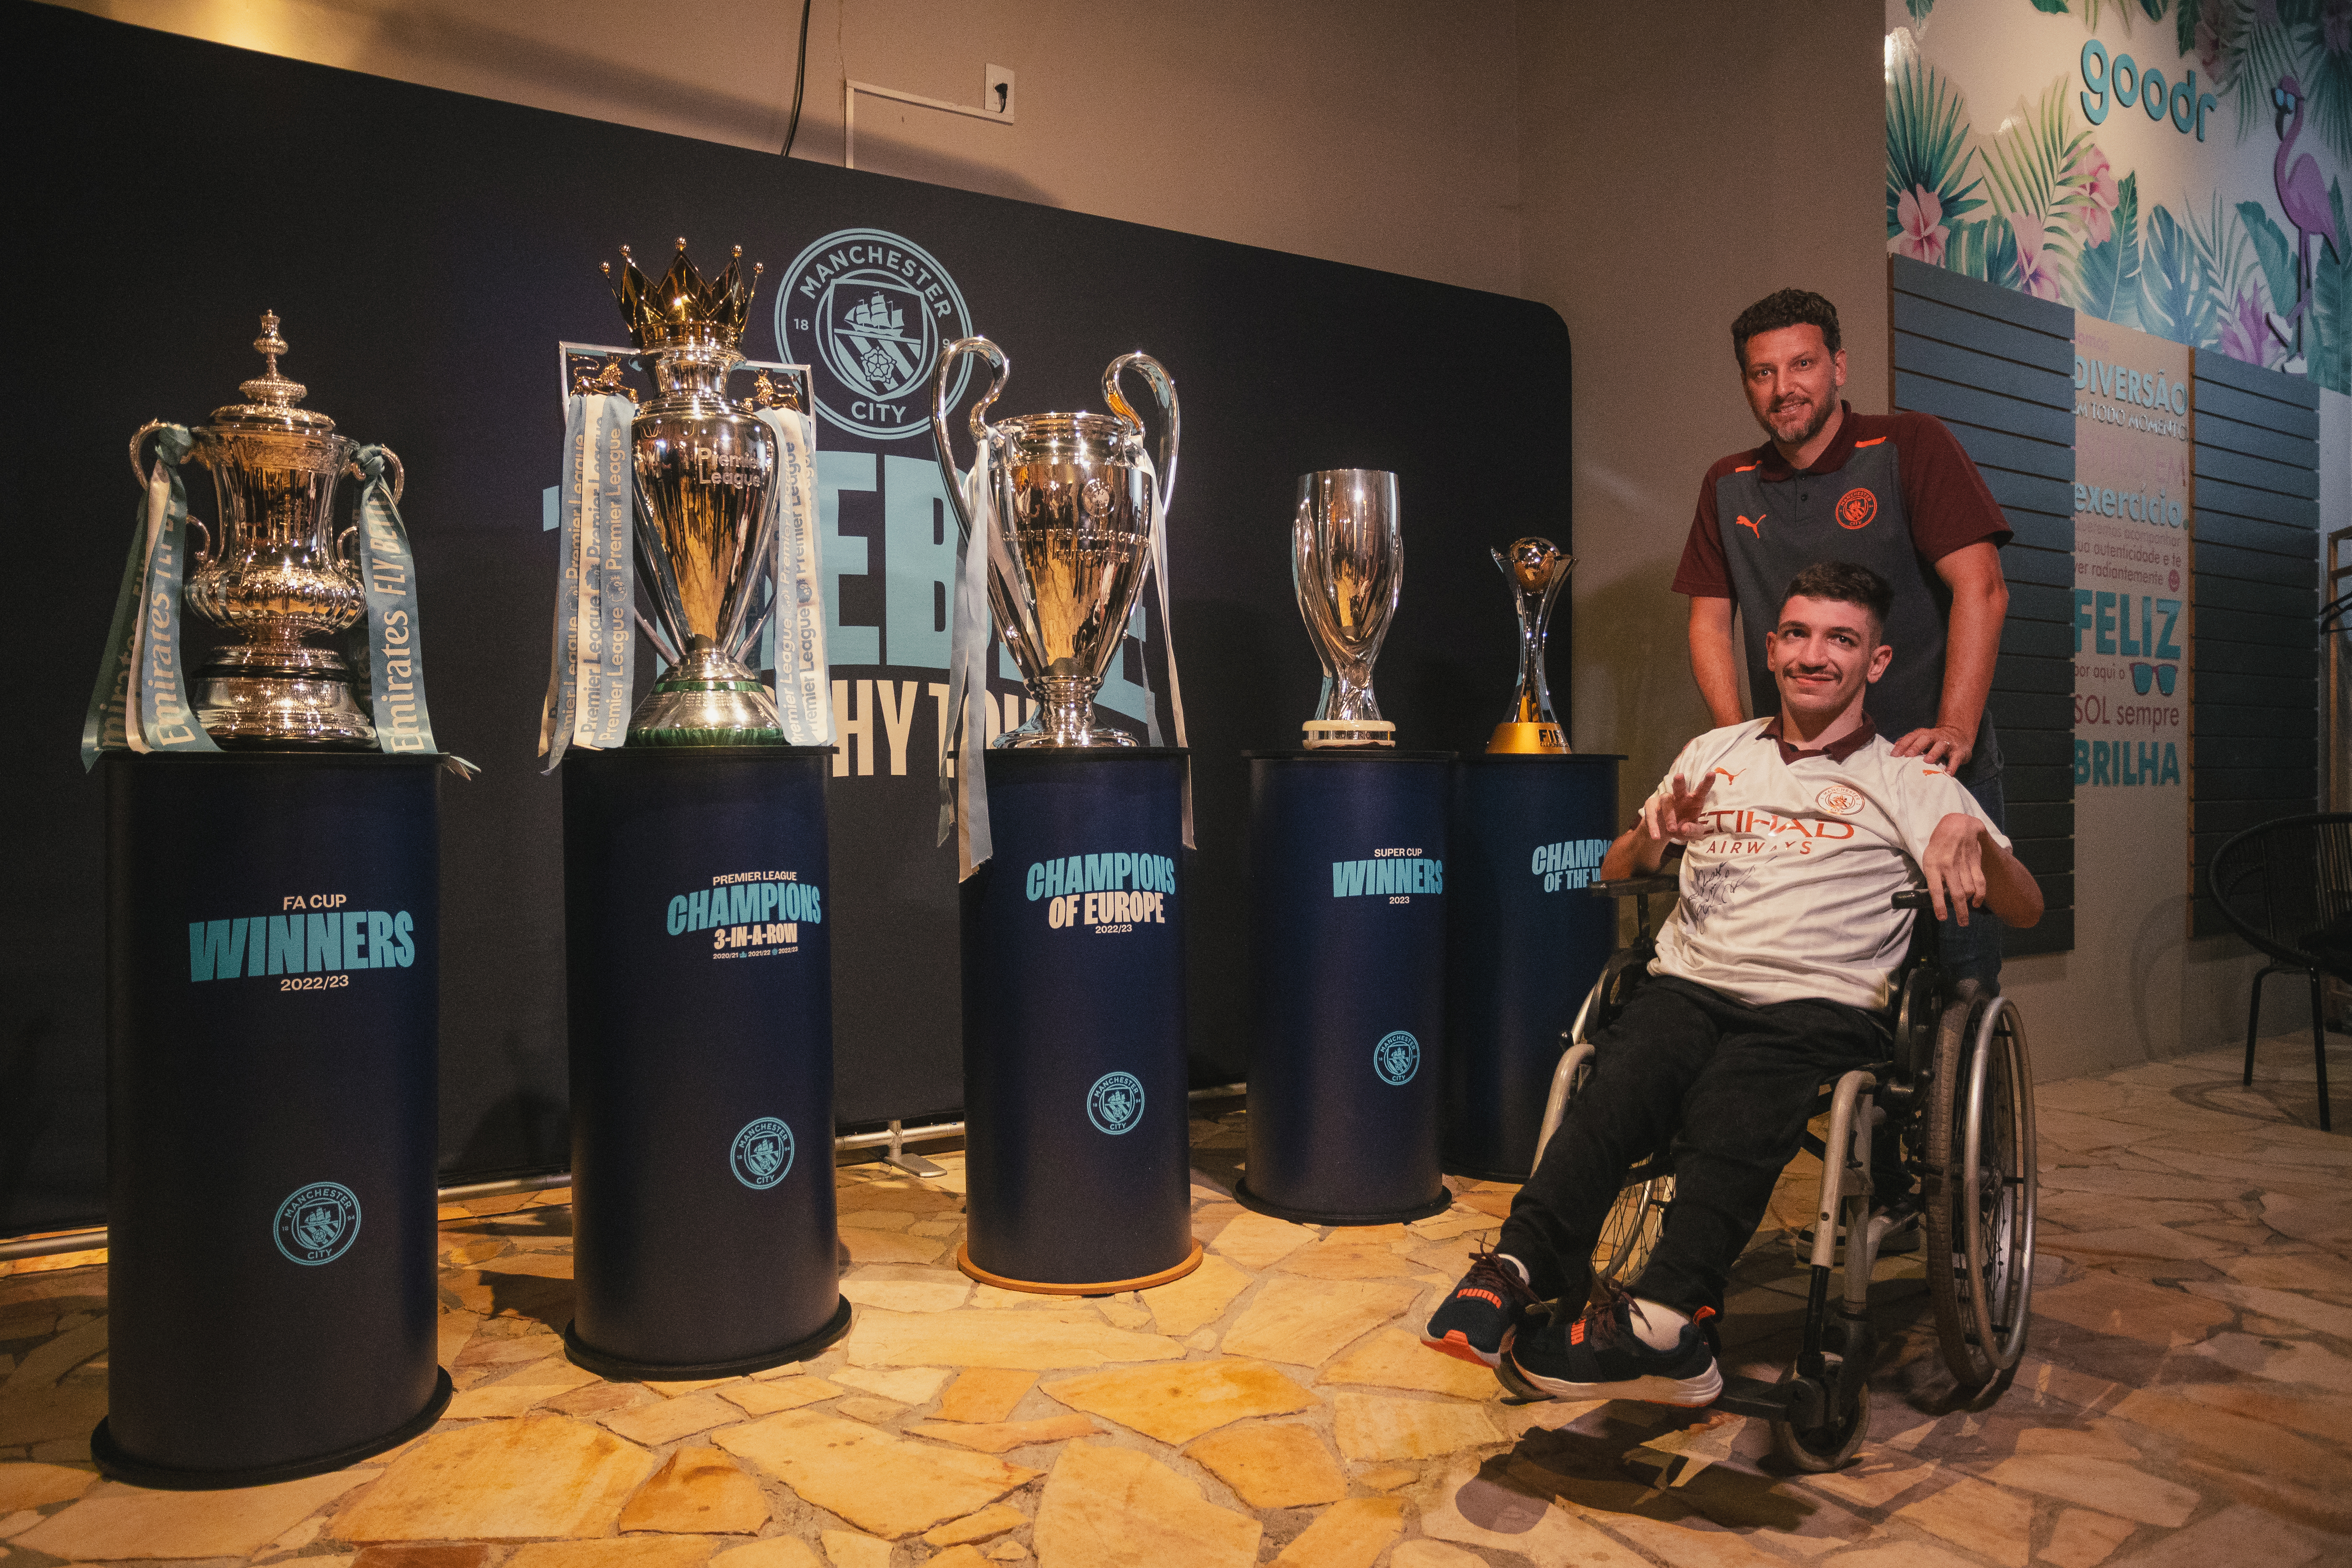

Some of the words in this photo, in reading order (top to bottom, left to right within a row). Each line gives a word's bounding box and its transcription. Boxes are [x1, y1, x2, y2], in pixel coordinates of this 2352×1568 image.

[2080, 39, 2217, 143] goodr
[800, 246, 952, 318] MANCHESTER
[794, 318, 809, 330] 18
[942, 338, 950, 348] 9
[2075, 332, 2109, 353] omos
[2075, 355, 2188, 417] DIVERSÃO
[851, 401, 906, 423] CITY
[2091, 401, 2126, 427] TODO
[2128, 414, 2188, 442] MOMENTO
[605, 428, 626, 496] League
[698, 447, 762, 470] Premier
[699, 472, 761, 490] League
[1841, 491, 1872, 506] MANCHESTER
[605, 502, 622, 570] Premier
[780, 520, 792, 584] Premier
[2093, 540, 2160, 565] autenticidade
[2162, 554, 2169, 566] e
[2171, 552, 2182, 568] te
[372, 558, 406, 596] FLY
[2092, 561, 2163, 586] radiantemente
[800, 606, 816, 672] League
[2075, 589, 2182, 660] FELIZ
[607, 607, 629, 676] League
[780, 618, 796, 684] League
[148, 591, 196, 746] Emirates
[381, 610, 424, 753] Emirates
[2118, 669, 2125, 680] o
[581, 669, 602, 733] Premier
[599, 679, 623, 741] Premier
[783, 686, 807, 743] Premier
[2075, 694, 2111, 724] SOL
[2116, 706, 2180, 734] sempre
[2075, 739, 2180, 786] BRILHA
[1823, 788, 1860, 800] MANCHESTER
[1374, 848, 1405, 857] SUPER
[1407, 848, 1423, 856] CUP
[713, 871, 761, 886] PREMIER
[763, 871, 797, 881] LEAGUE
[1026, 852, 1176, 901] CHAMPIONS
[1333, 858, 1443, 898] WINNERS
[1544, 871, 1563, 893] OF
[283, 896, 306, 910] FA
[310, 894, 347, 909] CUP
[667, 882, 821, 936] CHAMPIONS
[1049, 894, 1080, 929] OF
[1084, 891, 1165, 925] EUROPE
[714, 923, 798, 950] 3-IN-A-ROW
[1095, 924, 1132, 934] 2022/23
[189, 910, 415, 982] WINNERS
[779, 946, 798, 954] 2022/23
[280, 974, 349, 991] 2022/23
[1380, 1035, 1416, 1053] MANCHESTER
[1094, 1077, 1139, 1098] MANCHESTER
[738, 1123, 788, 1148] MANCHESTER
[756, 1174, 775, 1184] CITY
[284, 1188, 352, 1218] MANCHESTER
[307, 1248, 332, 1259] CITY
[1456, 1288, 1502, 1310] PUMA
